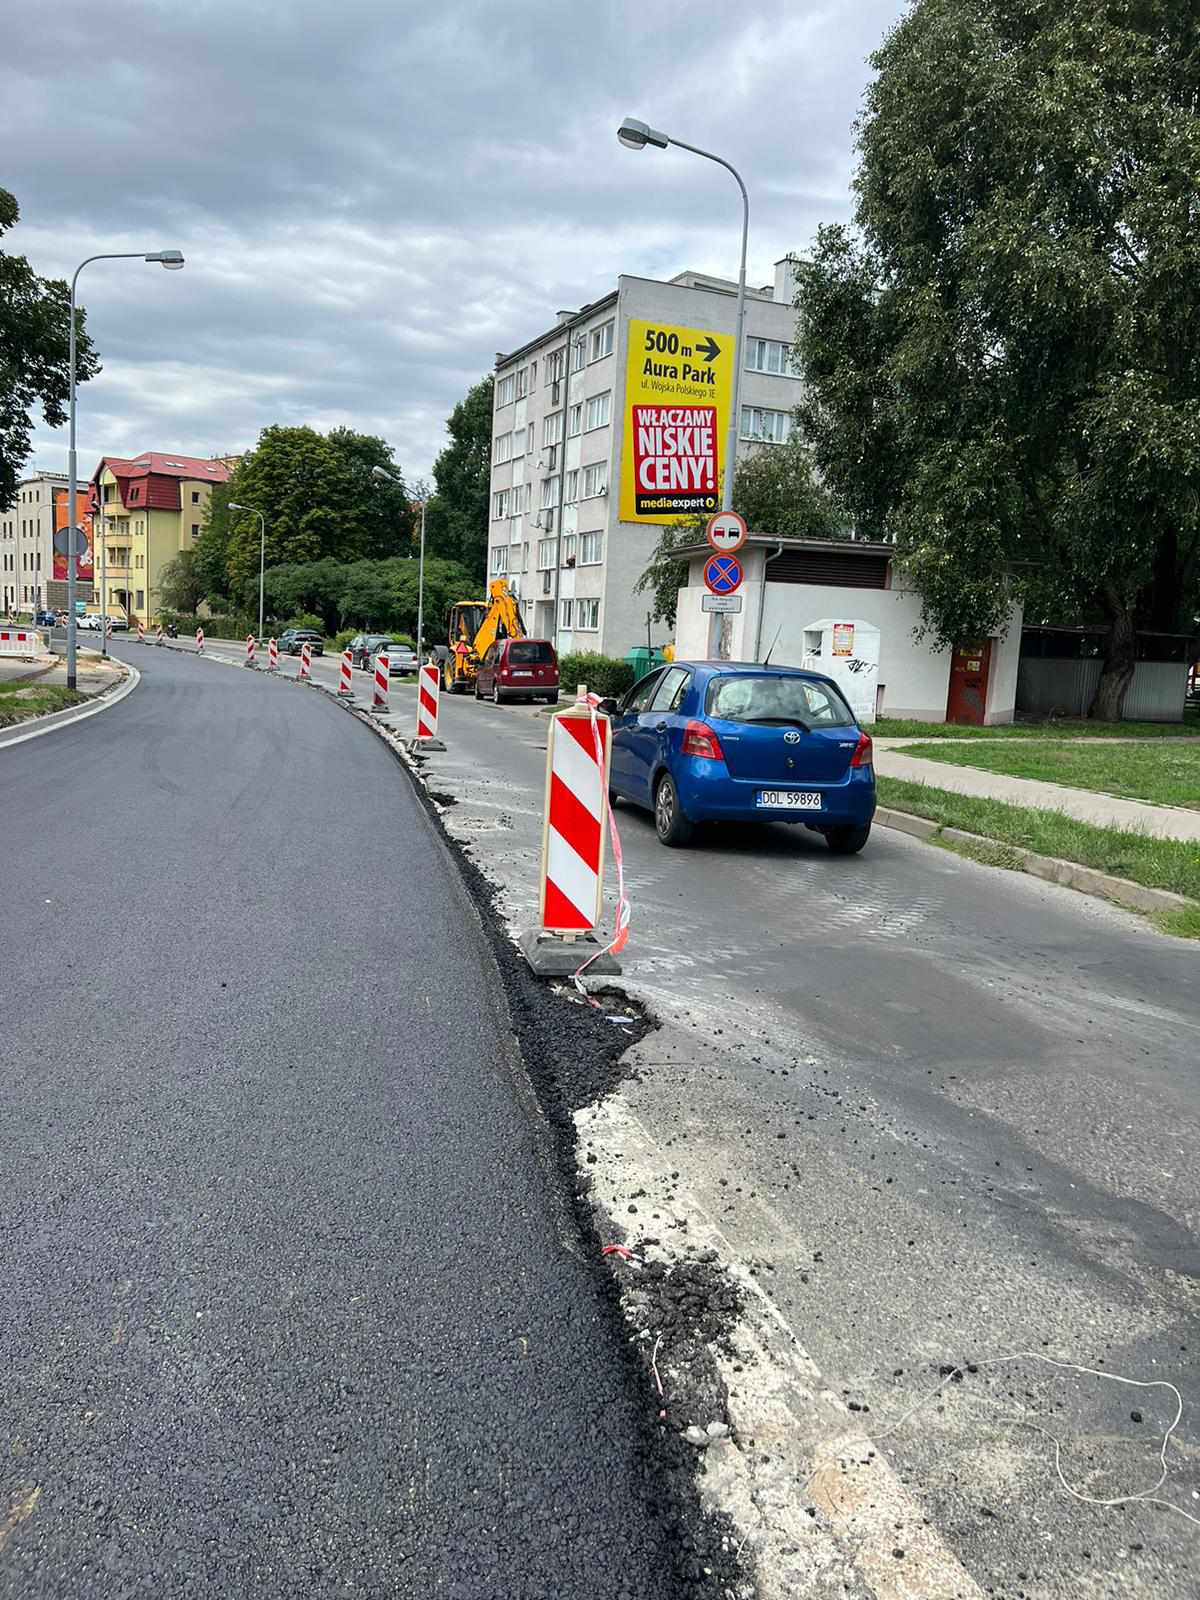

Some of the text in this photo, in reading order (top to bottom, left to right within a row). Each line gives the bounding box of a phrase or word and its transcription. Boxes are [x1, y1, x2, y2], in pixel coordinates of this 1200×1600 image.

[644, 329, 692, 357] 500 m
[643, 358, 715, 385] Aura Park
[641, 380, 649, 389] ul.
[651, 381, 674, 393] Wojska
[676, 384, 706, 399] Polskiego
[637, 409, 713, 428] WŁĄCZAMY
[638, 427, 713, 456] NISKIE
[639, 456, 714, 490] CENY!
[640, 497, 704, 509] mediaexpert
[763, 792, 783, 804] DOL
[787, 793, 820, 806] 59896
